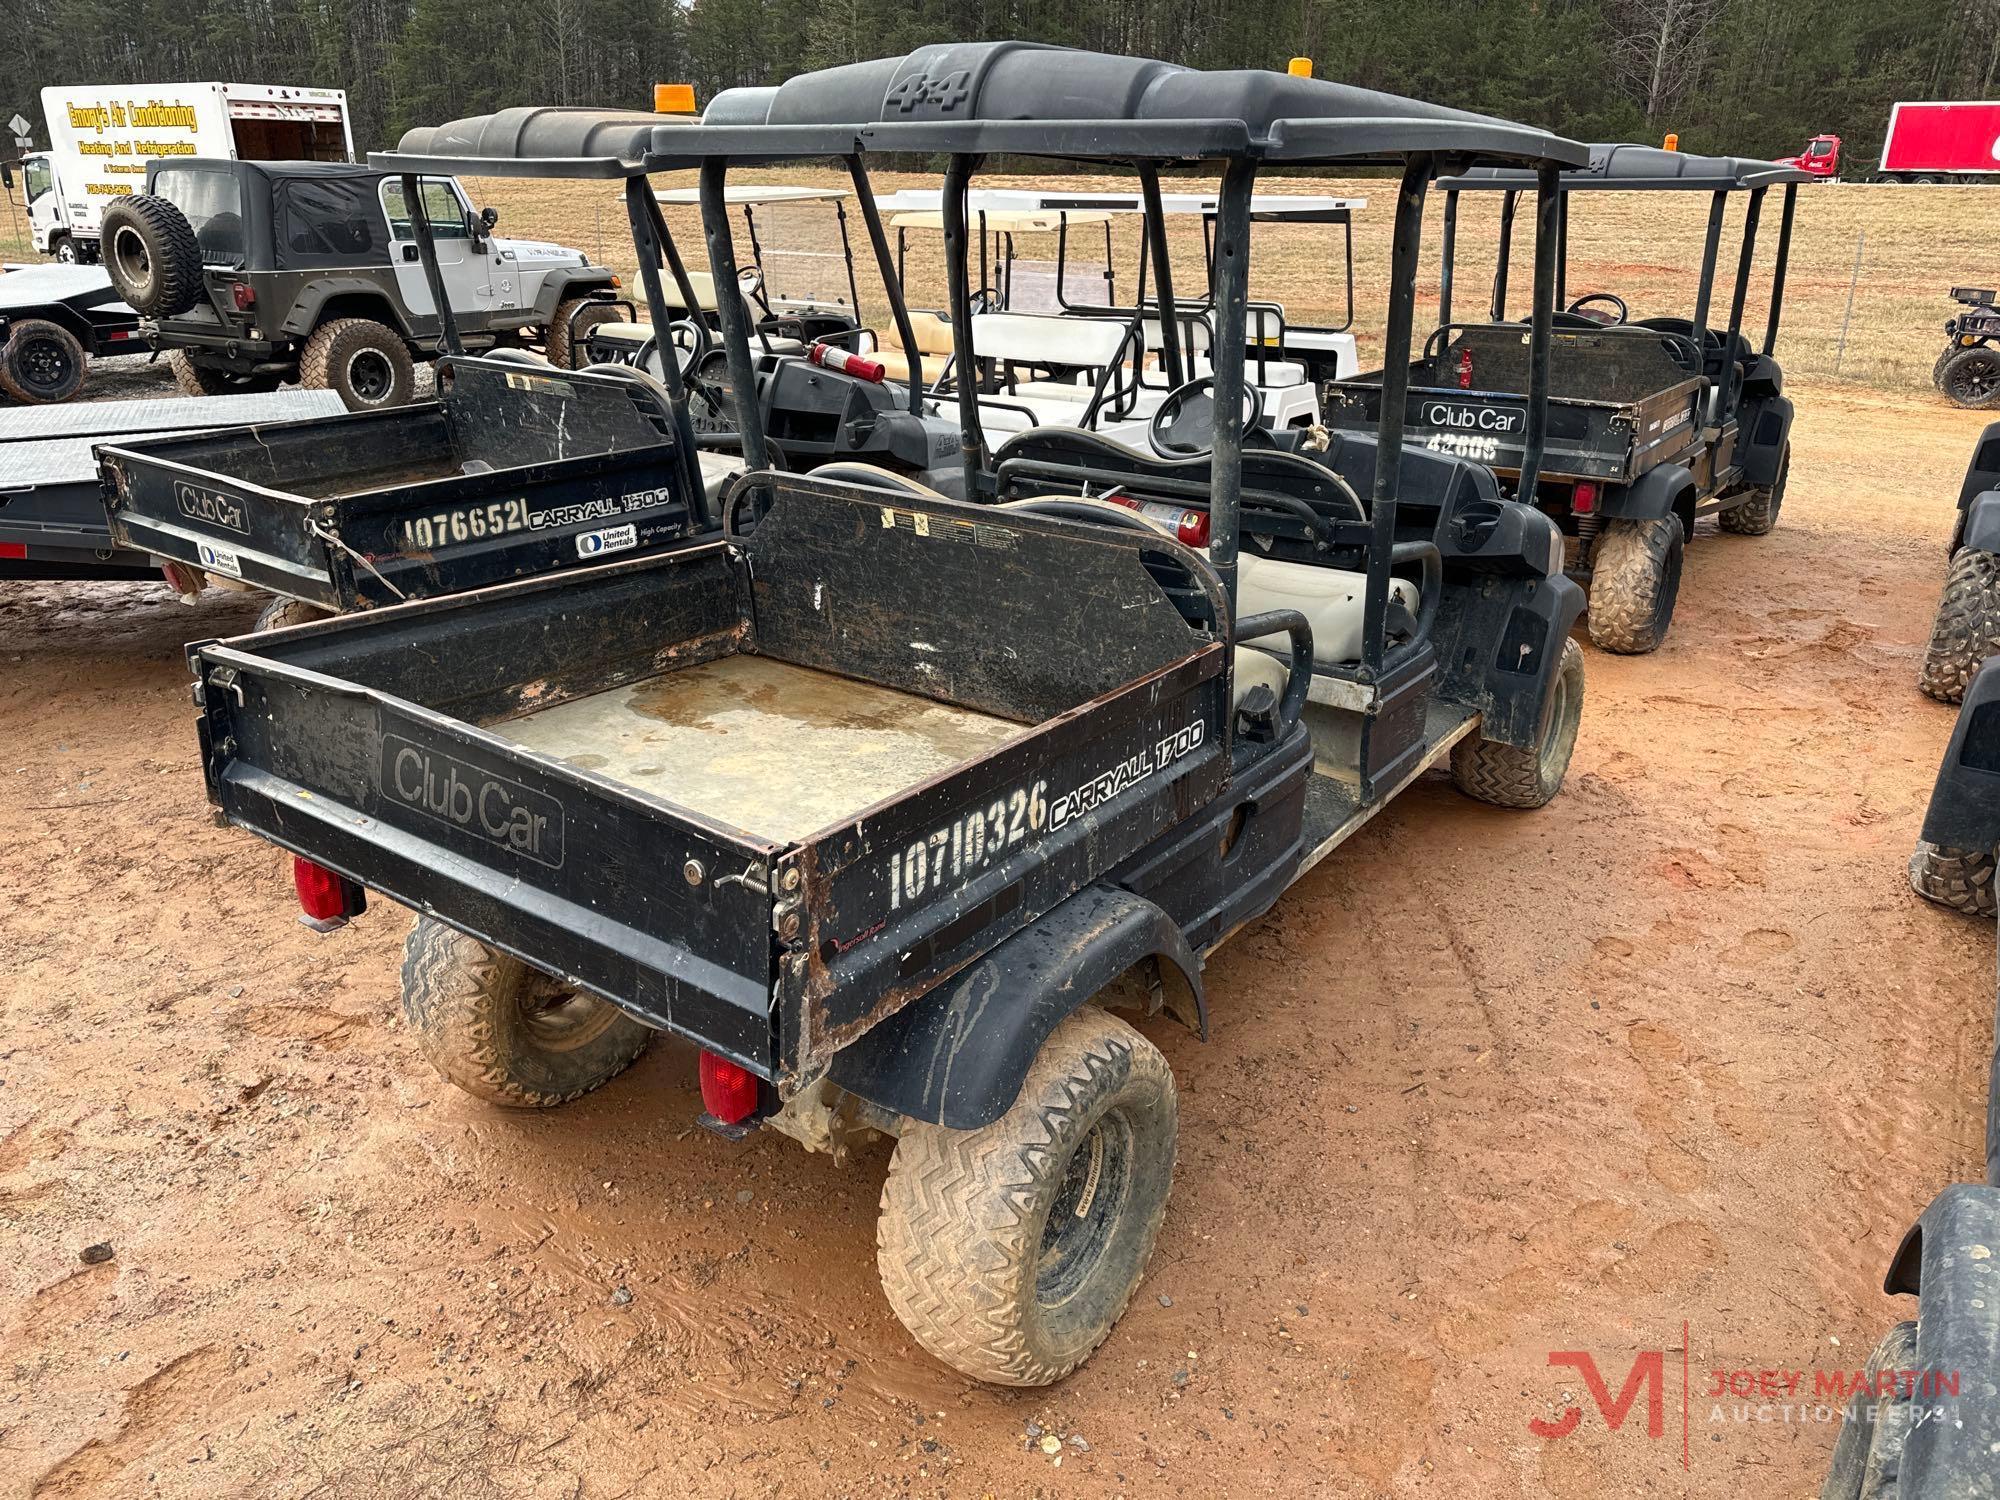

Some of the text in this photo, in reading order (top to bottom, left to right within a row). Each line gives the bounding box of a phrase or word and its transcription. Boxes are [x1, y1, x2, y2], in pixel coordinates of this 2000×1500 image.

[885, 71, 969, 113] 4x4
[66, 99, 198, 134] Emory's Air Conditioning
[78, 140, 197, 157] Heating And Refrigeration
[1430, 405, 1516, 431] Club Car
[182, 487, 241, 528] Club Car
[528, 498, 621, 531] CARRYALL
[621, 487, 669, 512] 1500
[602, 527, 630, 541] United
[641, 522, 682, 536] High Capacity
[215, 550, 233, 562] United
[603, 536, 634, 550] Rentals
[216, 559, 238, 572] Rentals
[1050, 750, 1152, 832] CARRYALL
[1156, 718, 1204, 770] 1700
[394, 748, 547, 853] Club Car
